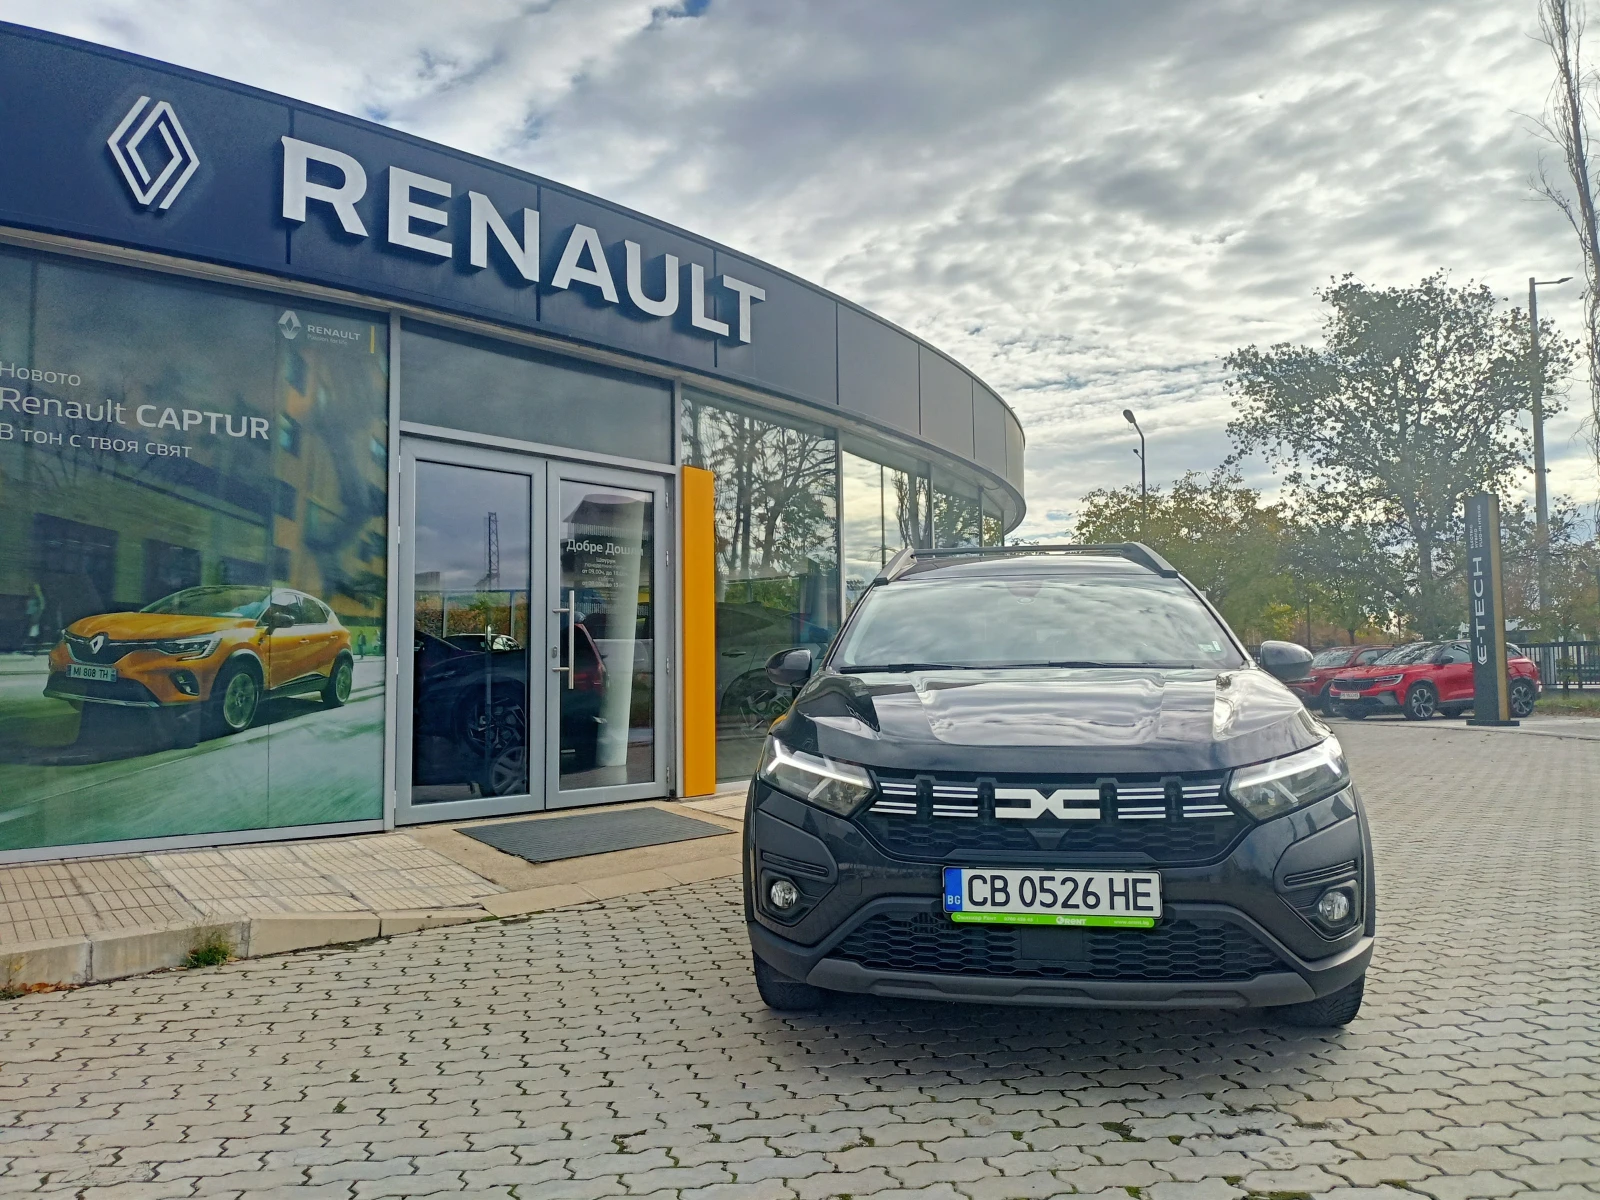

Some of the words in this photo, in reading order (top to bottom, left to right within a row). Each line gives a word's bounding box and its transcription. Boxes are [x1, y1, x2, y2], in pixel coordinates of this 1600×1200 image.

[281, 135, 766, 344] RENAULT
[307, 324, 361, 341] RENAULT
[0, 361, 81, 387] Новото
[0, 386, 126, 425] Renault
[136, 404, 270, 440] CAPTUR
[20, 429, 63, 446] тон
[87, 435, 139, 453] твоя
[145, 442, 193, 459] свят
[566, 539, 604, 555] Добре
[1472, 556, 1488, 665] E-TECH
[947, 895, 961, 905] BG
[967, 874, 1011, 907] CB
[1018, 875, 1101, 910] 0526
[1108, 877, 1154, 911] HE
